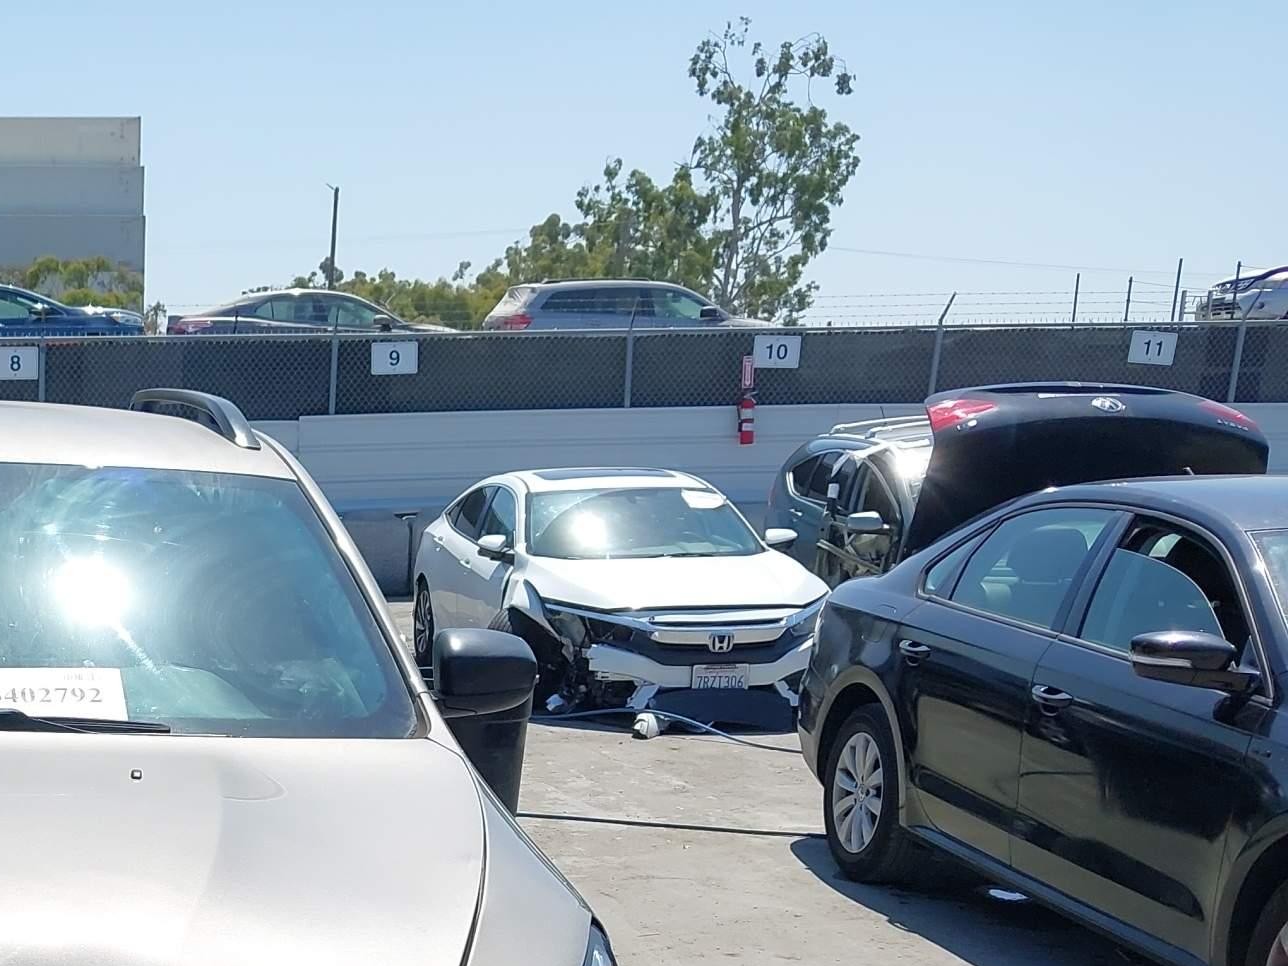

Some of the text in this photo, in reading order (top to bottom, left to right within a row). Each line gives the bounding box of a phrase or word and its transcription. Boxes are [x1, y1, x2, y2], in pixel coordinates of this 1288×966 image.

[765, 343, 788, 360] 10
[1143, 339, 1163, 357] 11
[10, 355, 21, 371] 8
[389, 350, 400, 367] 9
